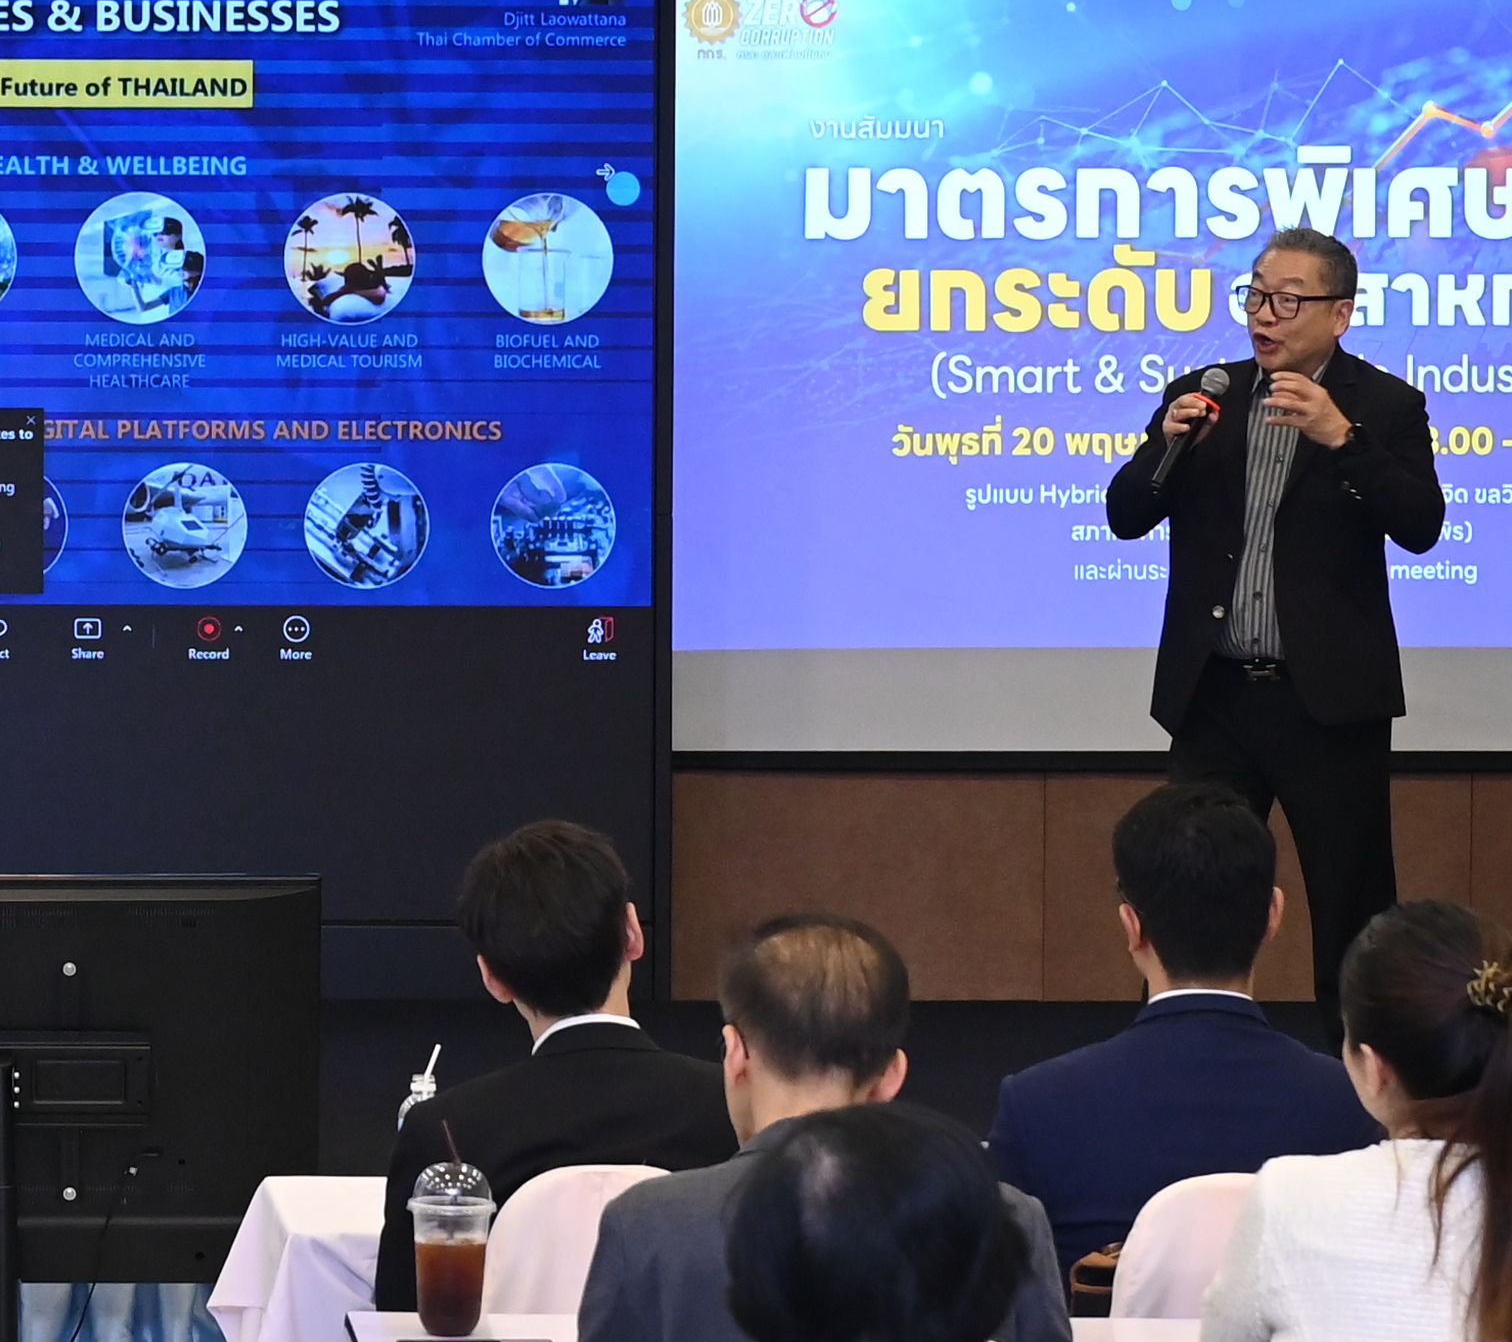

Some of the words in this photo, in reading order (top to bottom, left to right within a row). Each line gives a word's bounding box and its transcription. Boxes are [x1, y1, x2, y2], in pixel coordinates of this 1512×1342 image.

[46, 0, 83, 33] &
[96, 0, 340, 33] BUSINESSES
[540, 12, 626, 27] Laowattana
[417, 32, 448, 47] Thai
[452, 32, 521, 47] Chamber
[525, 32, 541, 47] of
[545, 33, 626, 47] Commerce
[740, 29, 836, 46] CORRUPTION
[0, 77, 78, 97] Future
[84, 77, 115, 97] of
[119, 77, 249, 98] THAILAND
[810, 115, 945, 139] งานสัมมนา
[78, 155, 99, 176] &
[106, 155, 248, 176] WELLBEING
[862, 244, 1212, 333] ยกระดับ
[84, 333, 154, 347] MEDICAL
[159, 333, 195, 347] AND
[280, 334, 378, 348] HIGH-VALUE
[382, 334, 419, 348] AND
[495, 334, 560, 349] BIOFUEL
[565, 334, 600, 349] AND
[73, 353, 206, 368] COMPREHENSIVE
[276, 354, 348, 369] MEDICAL
[351, 354, 423, 369] TOURISM
[494, 354, 601, 369] BIOCHEMICAL
[89, 374, 190, 388] HEALTHCARE
[930, 351, 1081, 399] (Smart
[1094, 356, 1125, 395] &
[19, 429, 34, 440] to
[44, 419, 109, 440] GITAL
[117, 420, 265, 440] PLATFORMS
[273, 421, 330, 440] AND
[338, 421, 502, 440] ELECTRONICS
[891, 415, 1003, 465] วันพุธที่
[1011, 426, 1055, 457] 20
[965, 483, 1034, 510] รูปแบบ
[1390, 560, 1478, 585] meeting
[72, 647, 104, 660] Share
[188, 647, 230, 660] Record
[280, 648, 312, 660] More
[583, 648, 616, 661] Leave
